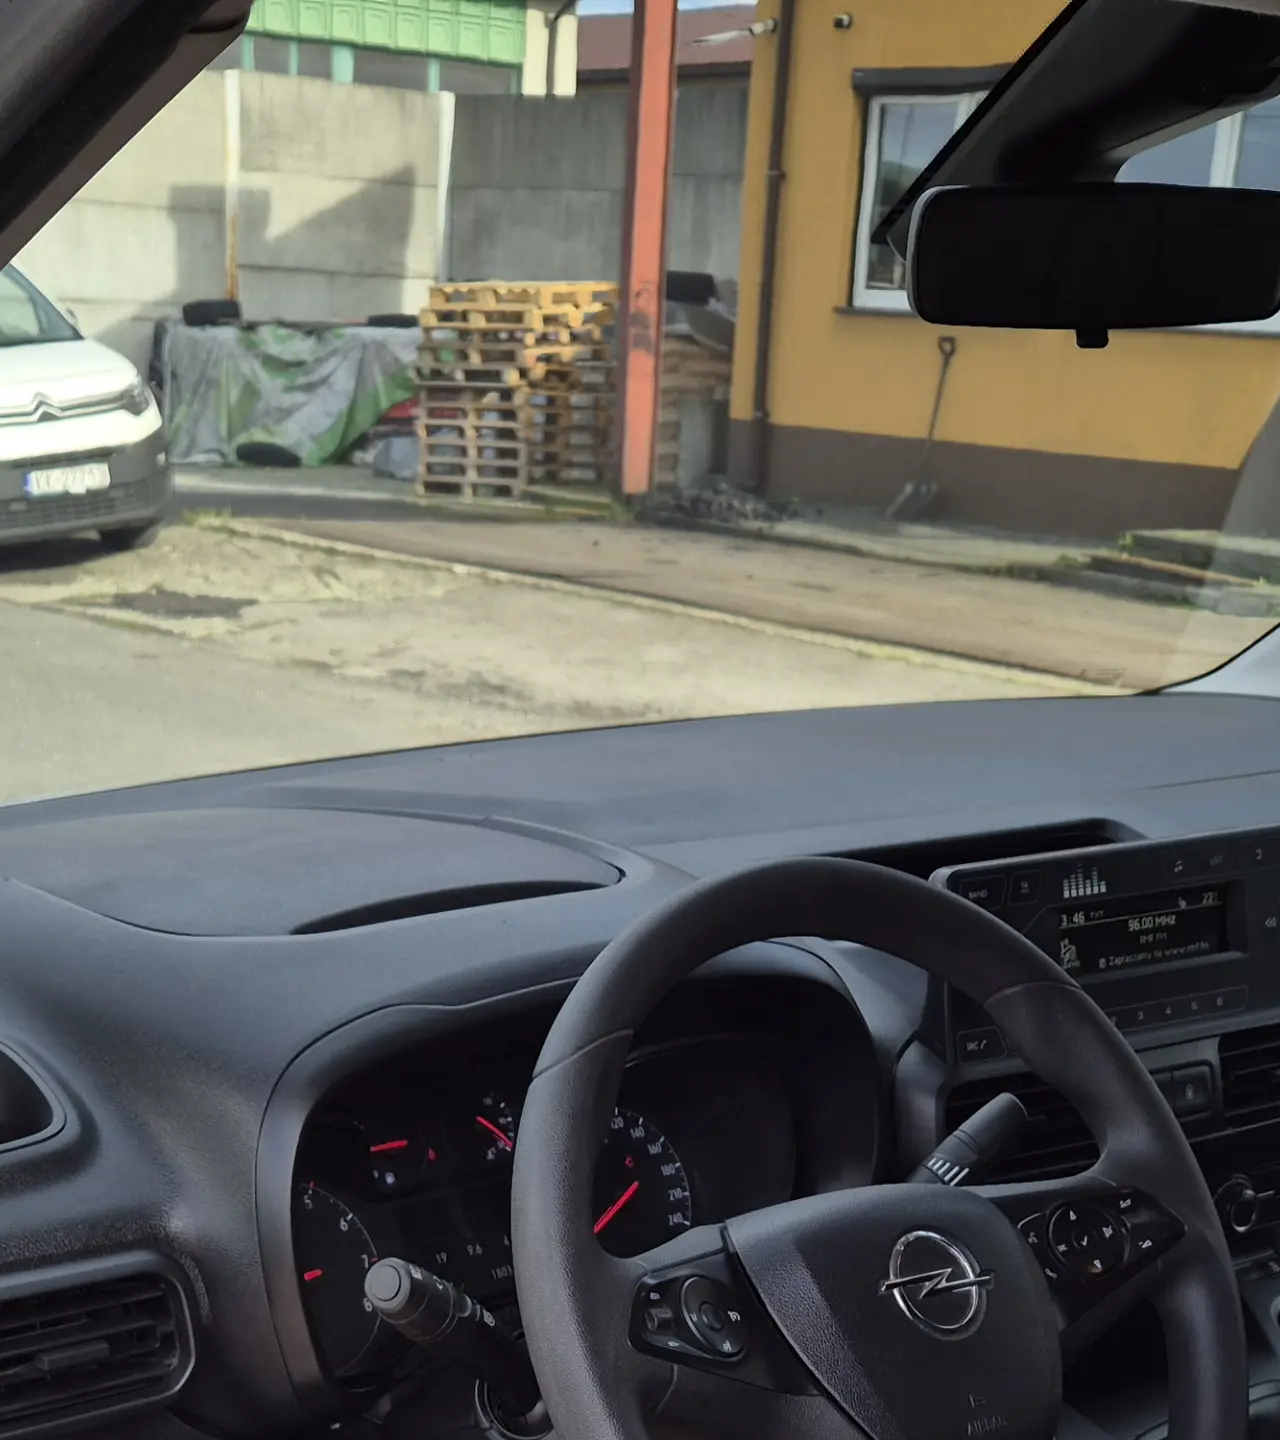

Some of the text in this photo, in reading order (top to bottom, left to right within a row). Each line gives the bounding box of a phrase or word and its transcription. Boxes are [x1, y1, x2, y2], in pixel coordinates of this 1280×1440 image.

[1061, 911, 1085, 926] 3:46
[1128, 914, 1177, 932] 96.00 MHz
[631, 1127, 645, 1138] 140
[647, 1142, 662, 1155] 160
[661, 1164, 675, 1176] 180
[668, 1188, 683, 1201] 210
[303, 1196, 313, 1210] 5
[339, 1218, 349, 1232] 6
[668, 1212, 683, 1226] 240
